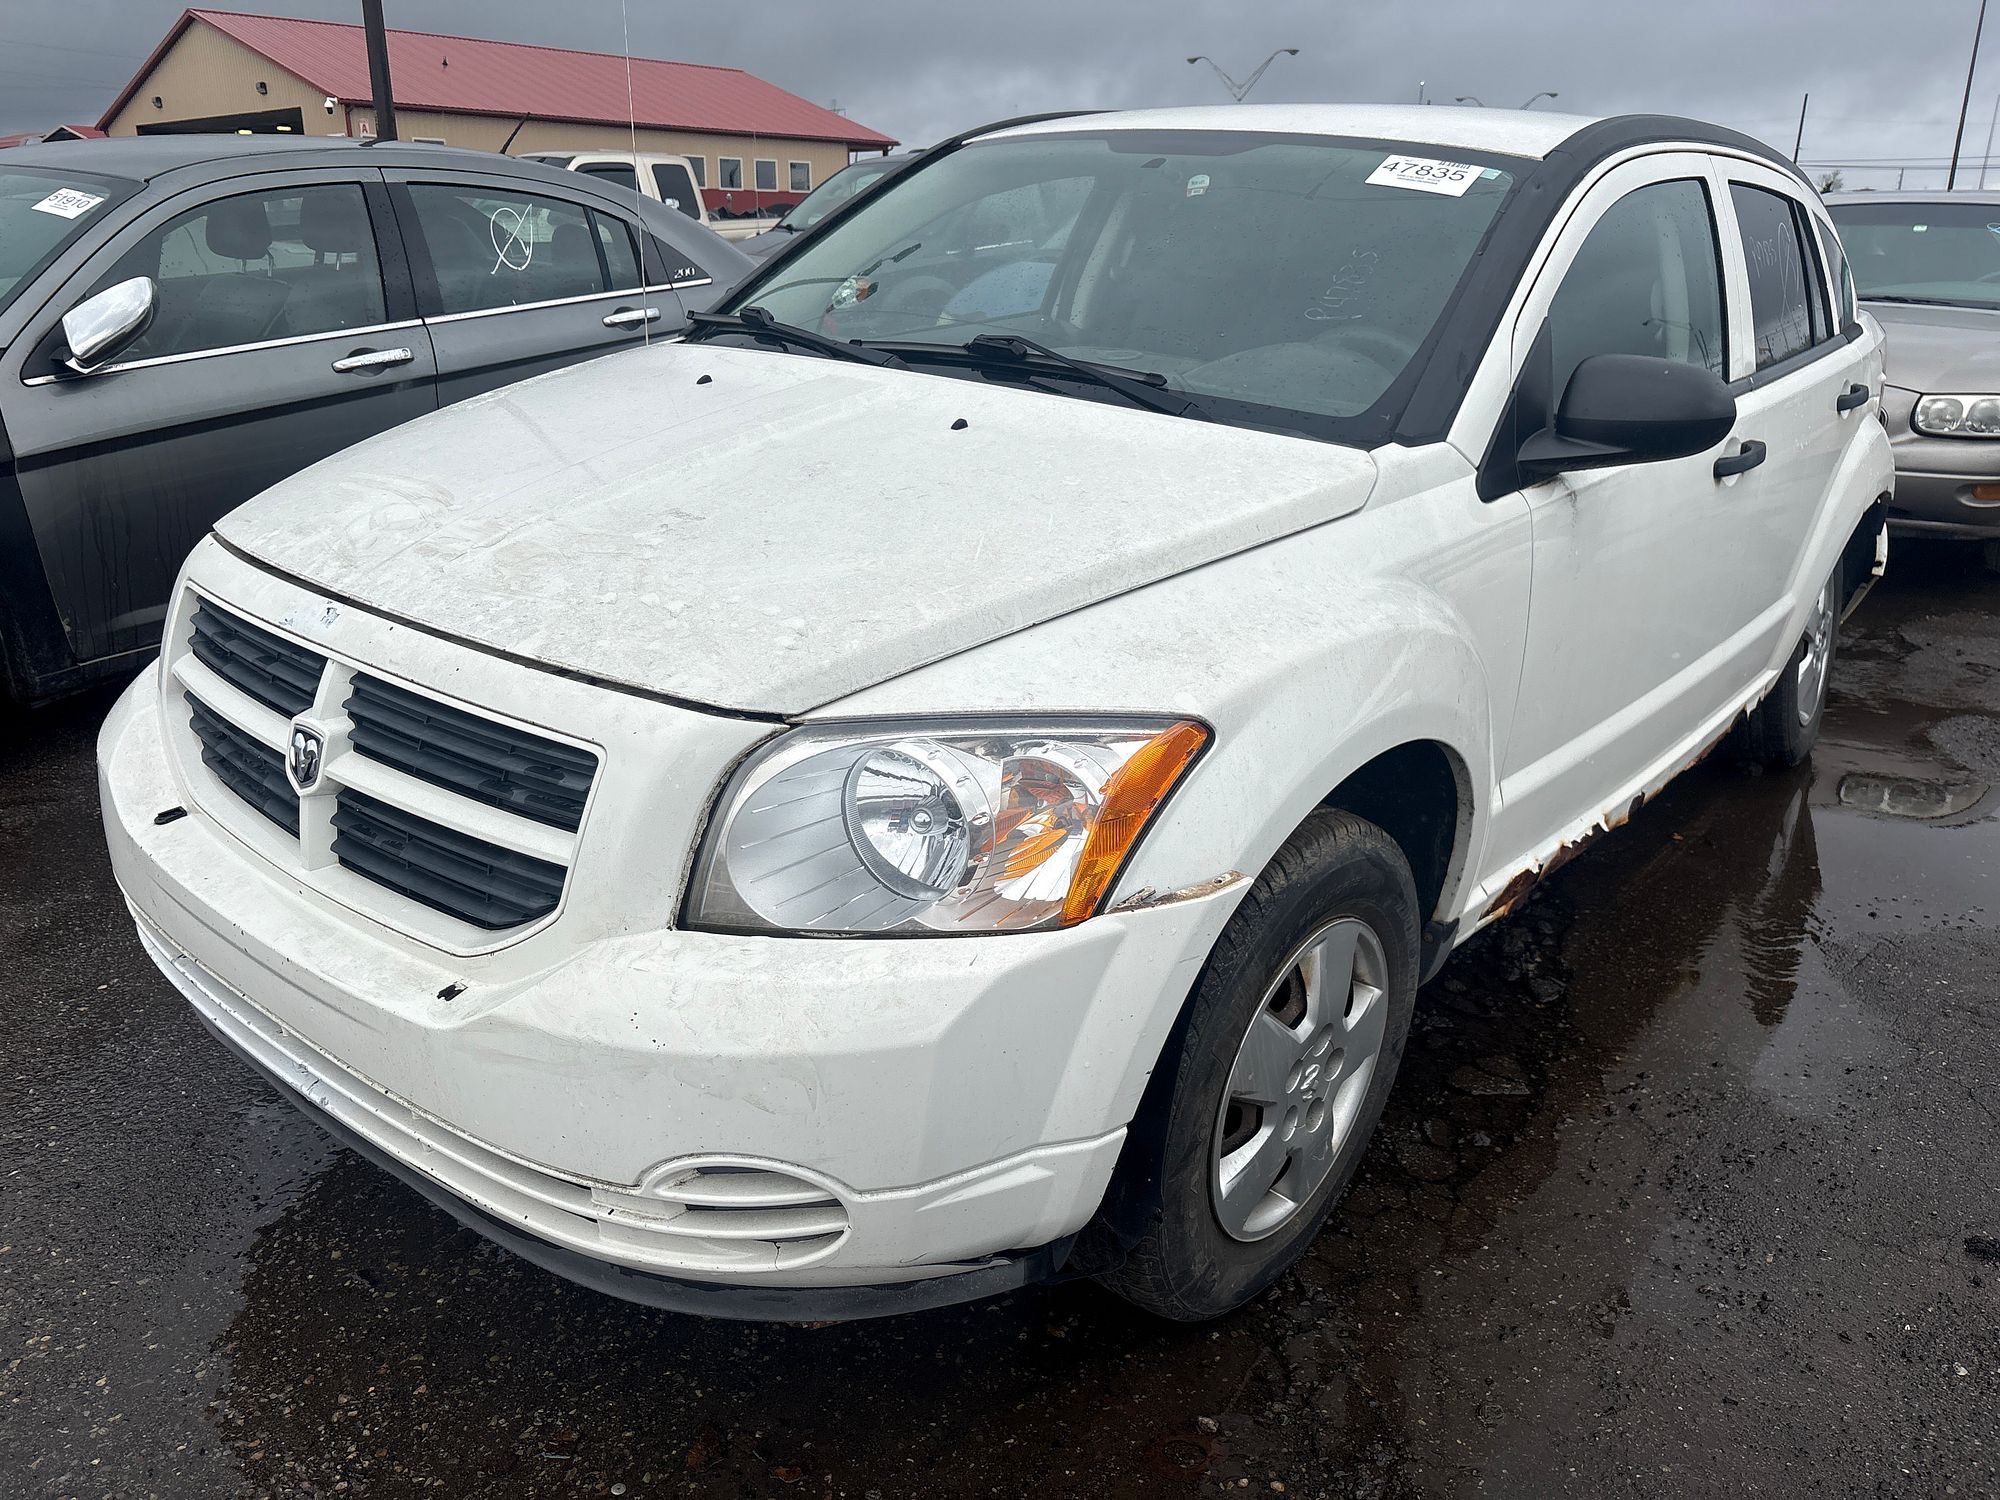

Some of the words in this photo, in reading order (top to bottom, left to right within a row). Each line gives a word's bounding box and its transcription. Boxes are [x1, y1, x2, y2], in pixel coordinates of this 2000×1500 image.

[361, 123, 369, 134] A
[1382, 161, 1469, 181] 47835
[48, 192, 91, 209] 51910
[674, 267, 696, 279] 200
